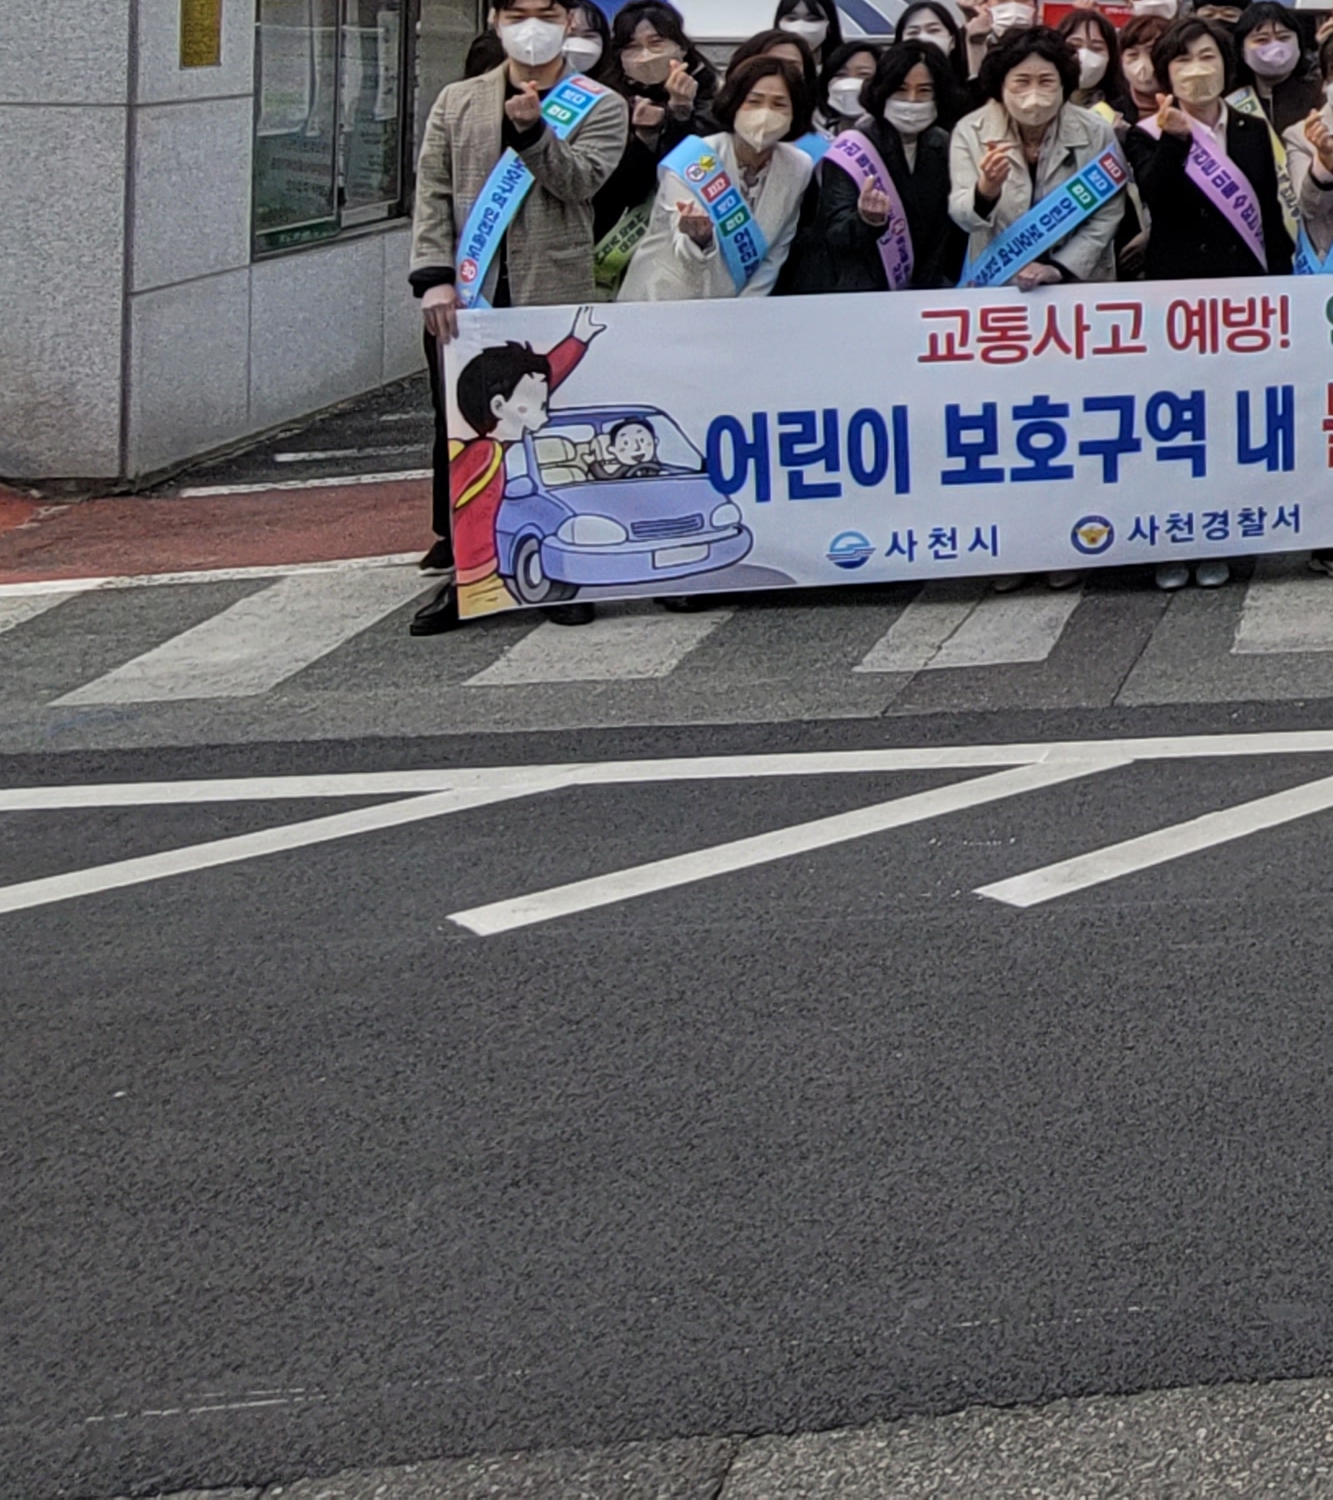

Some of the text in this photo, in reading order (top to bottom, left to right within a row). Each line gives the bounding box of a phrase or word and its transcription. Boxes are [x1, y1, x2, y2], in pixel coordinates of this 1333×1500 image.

[1039, 196, 1077, 233] 어린이
[917, 303, 1146, 364] 교통사고
[1168, 296, 1289, 353] 예방!
[705, 404, 910, 502] 어린이
[941, 390, 1206, 485] 보호구역
[1236, 385, 1294, 472] 내
[886, 526, 997, 562] 사천시
[1128, 505, 1300, 545] 사천경찰서
